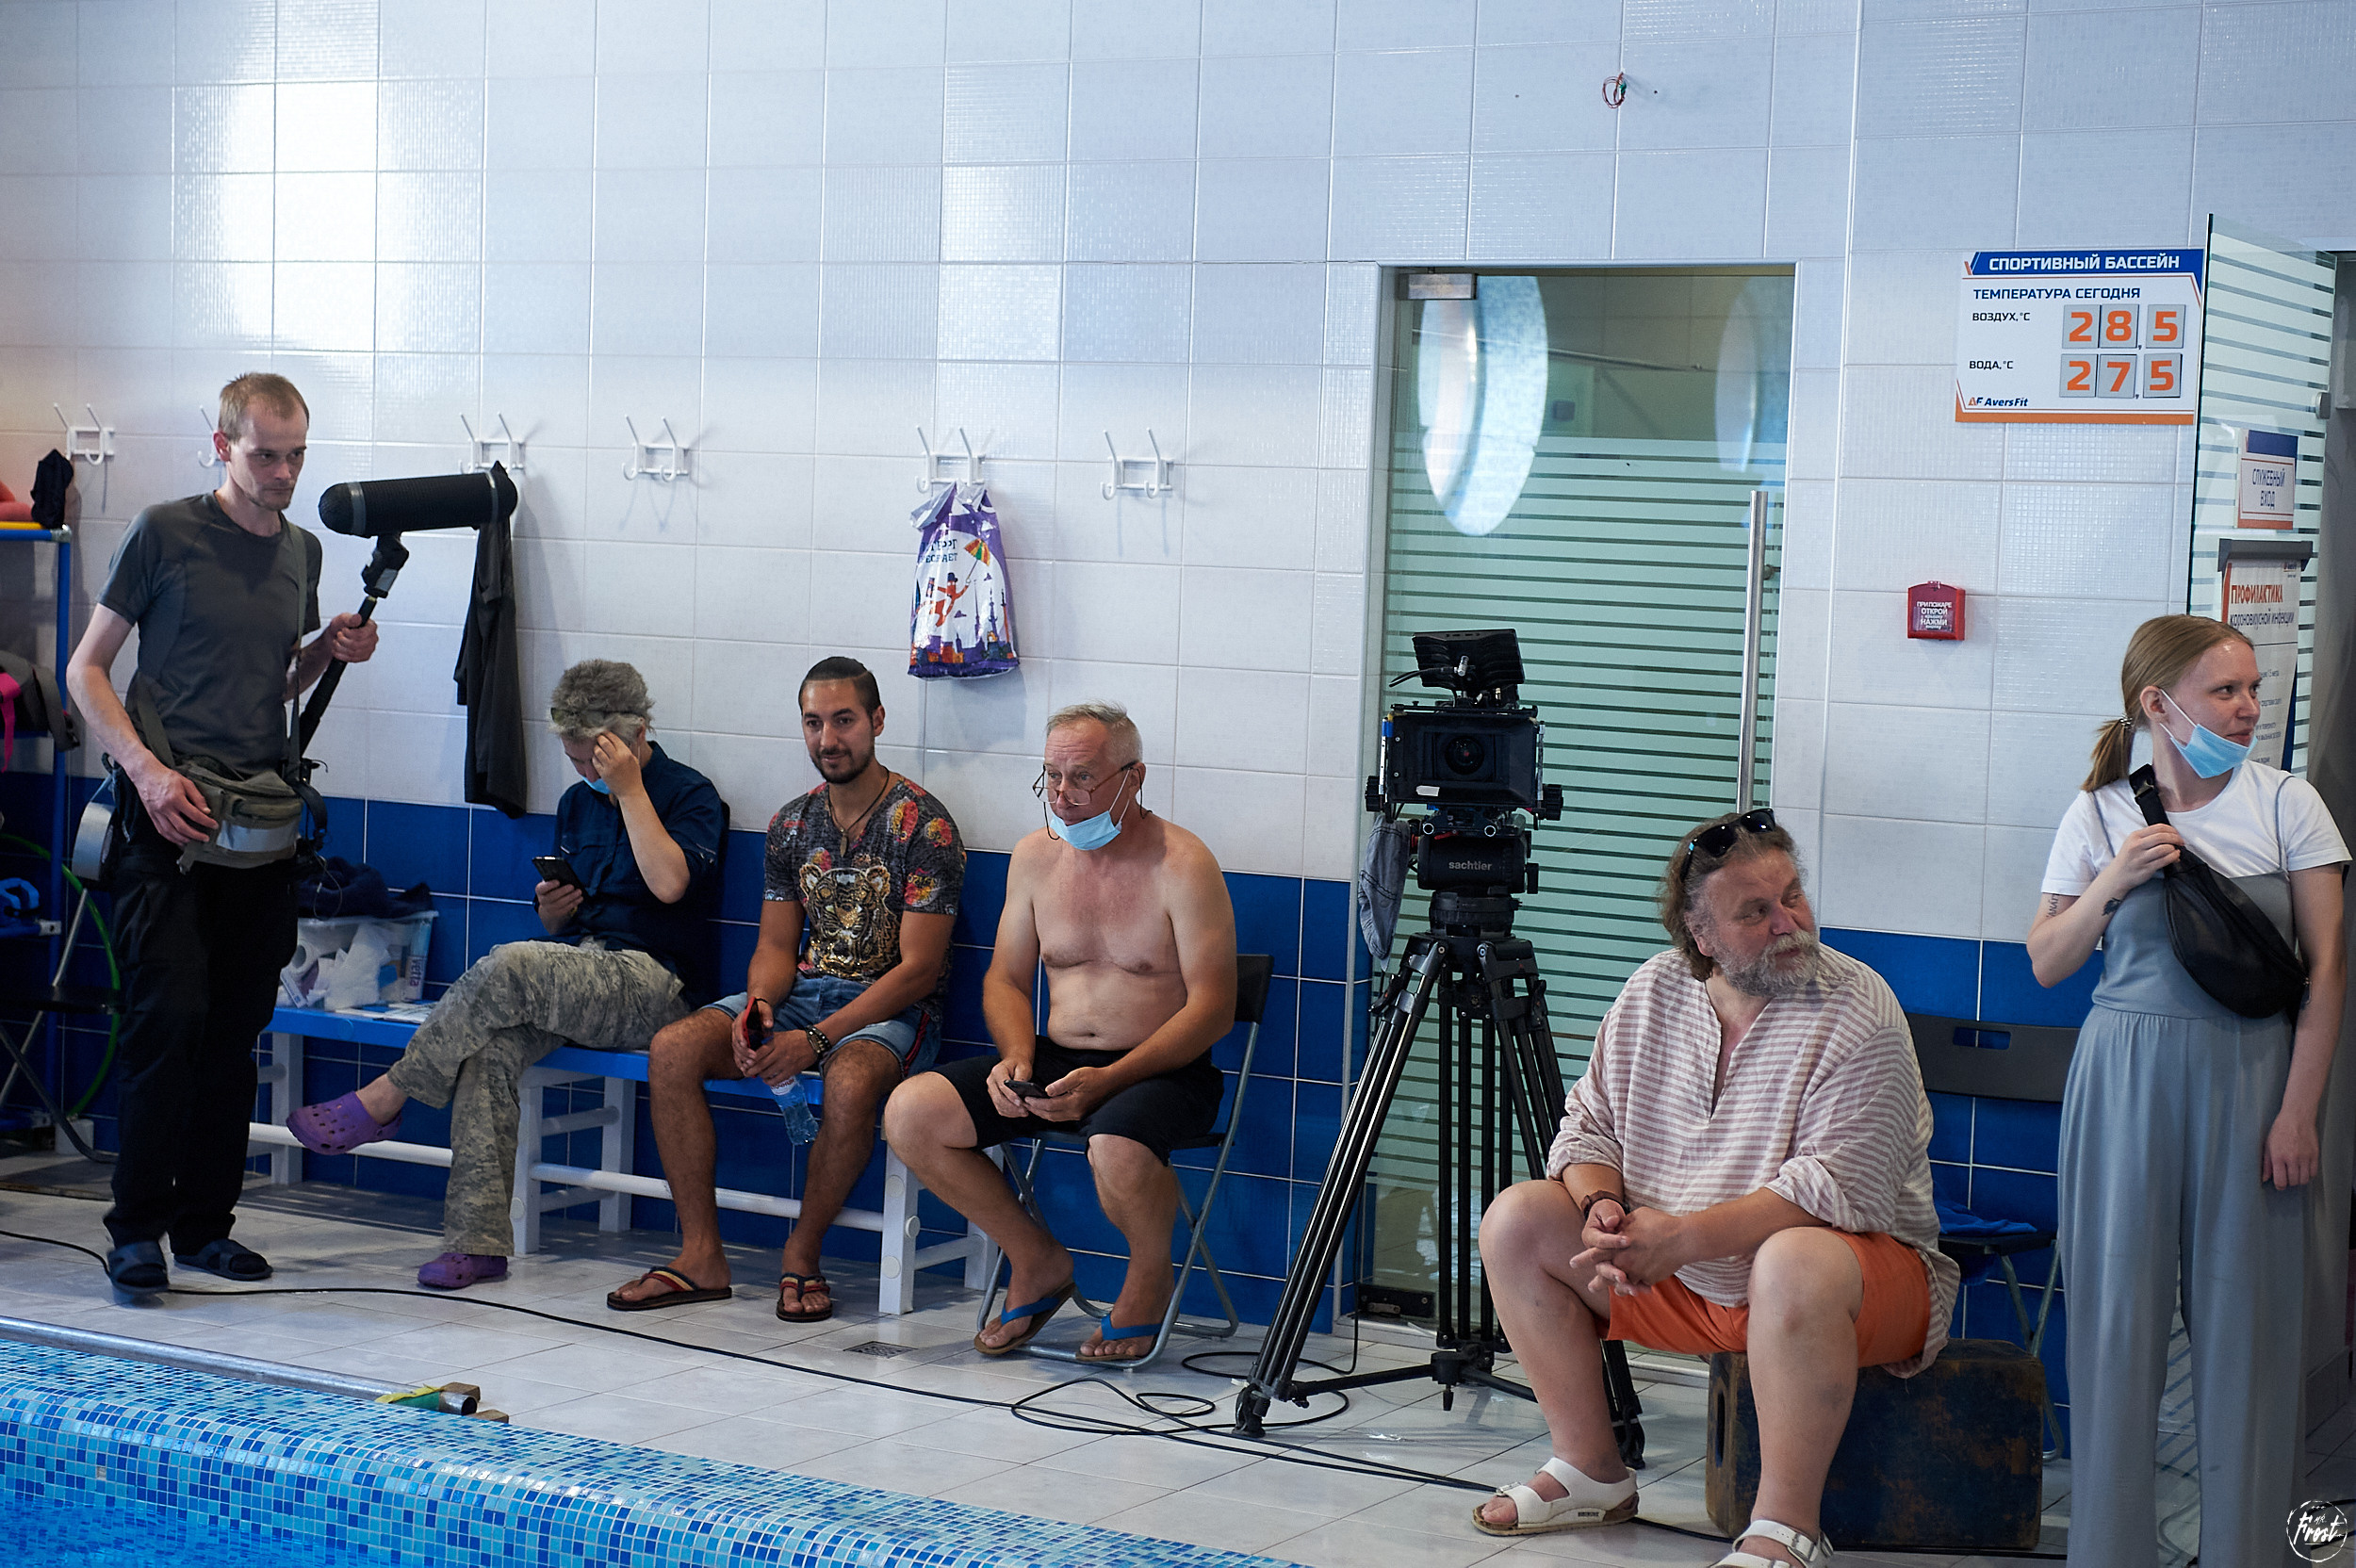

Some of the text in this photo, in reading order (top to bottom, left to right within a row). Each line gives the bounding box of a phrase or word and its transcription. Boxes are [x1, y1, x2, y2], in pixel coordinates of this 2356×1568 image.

[1988, 253, 2180, 270] СПОРТИВНЫЙ БАССЕЙН
[1972, 287, 2140, 301] ТЕМПЕРАТУРА СЕГОДНЯ
[1984, 397, 2029, 407] AversFit
[2252, 467, 2285, 487] СЛУЖЕБНЫЙ
[2260, 490, 2276, 510] ВХОД
[2231, 584, 2283, 604] ПРОФИЛАКТИКА
